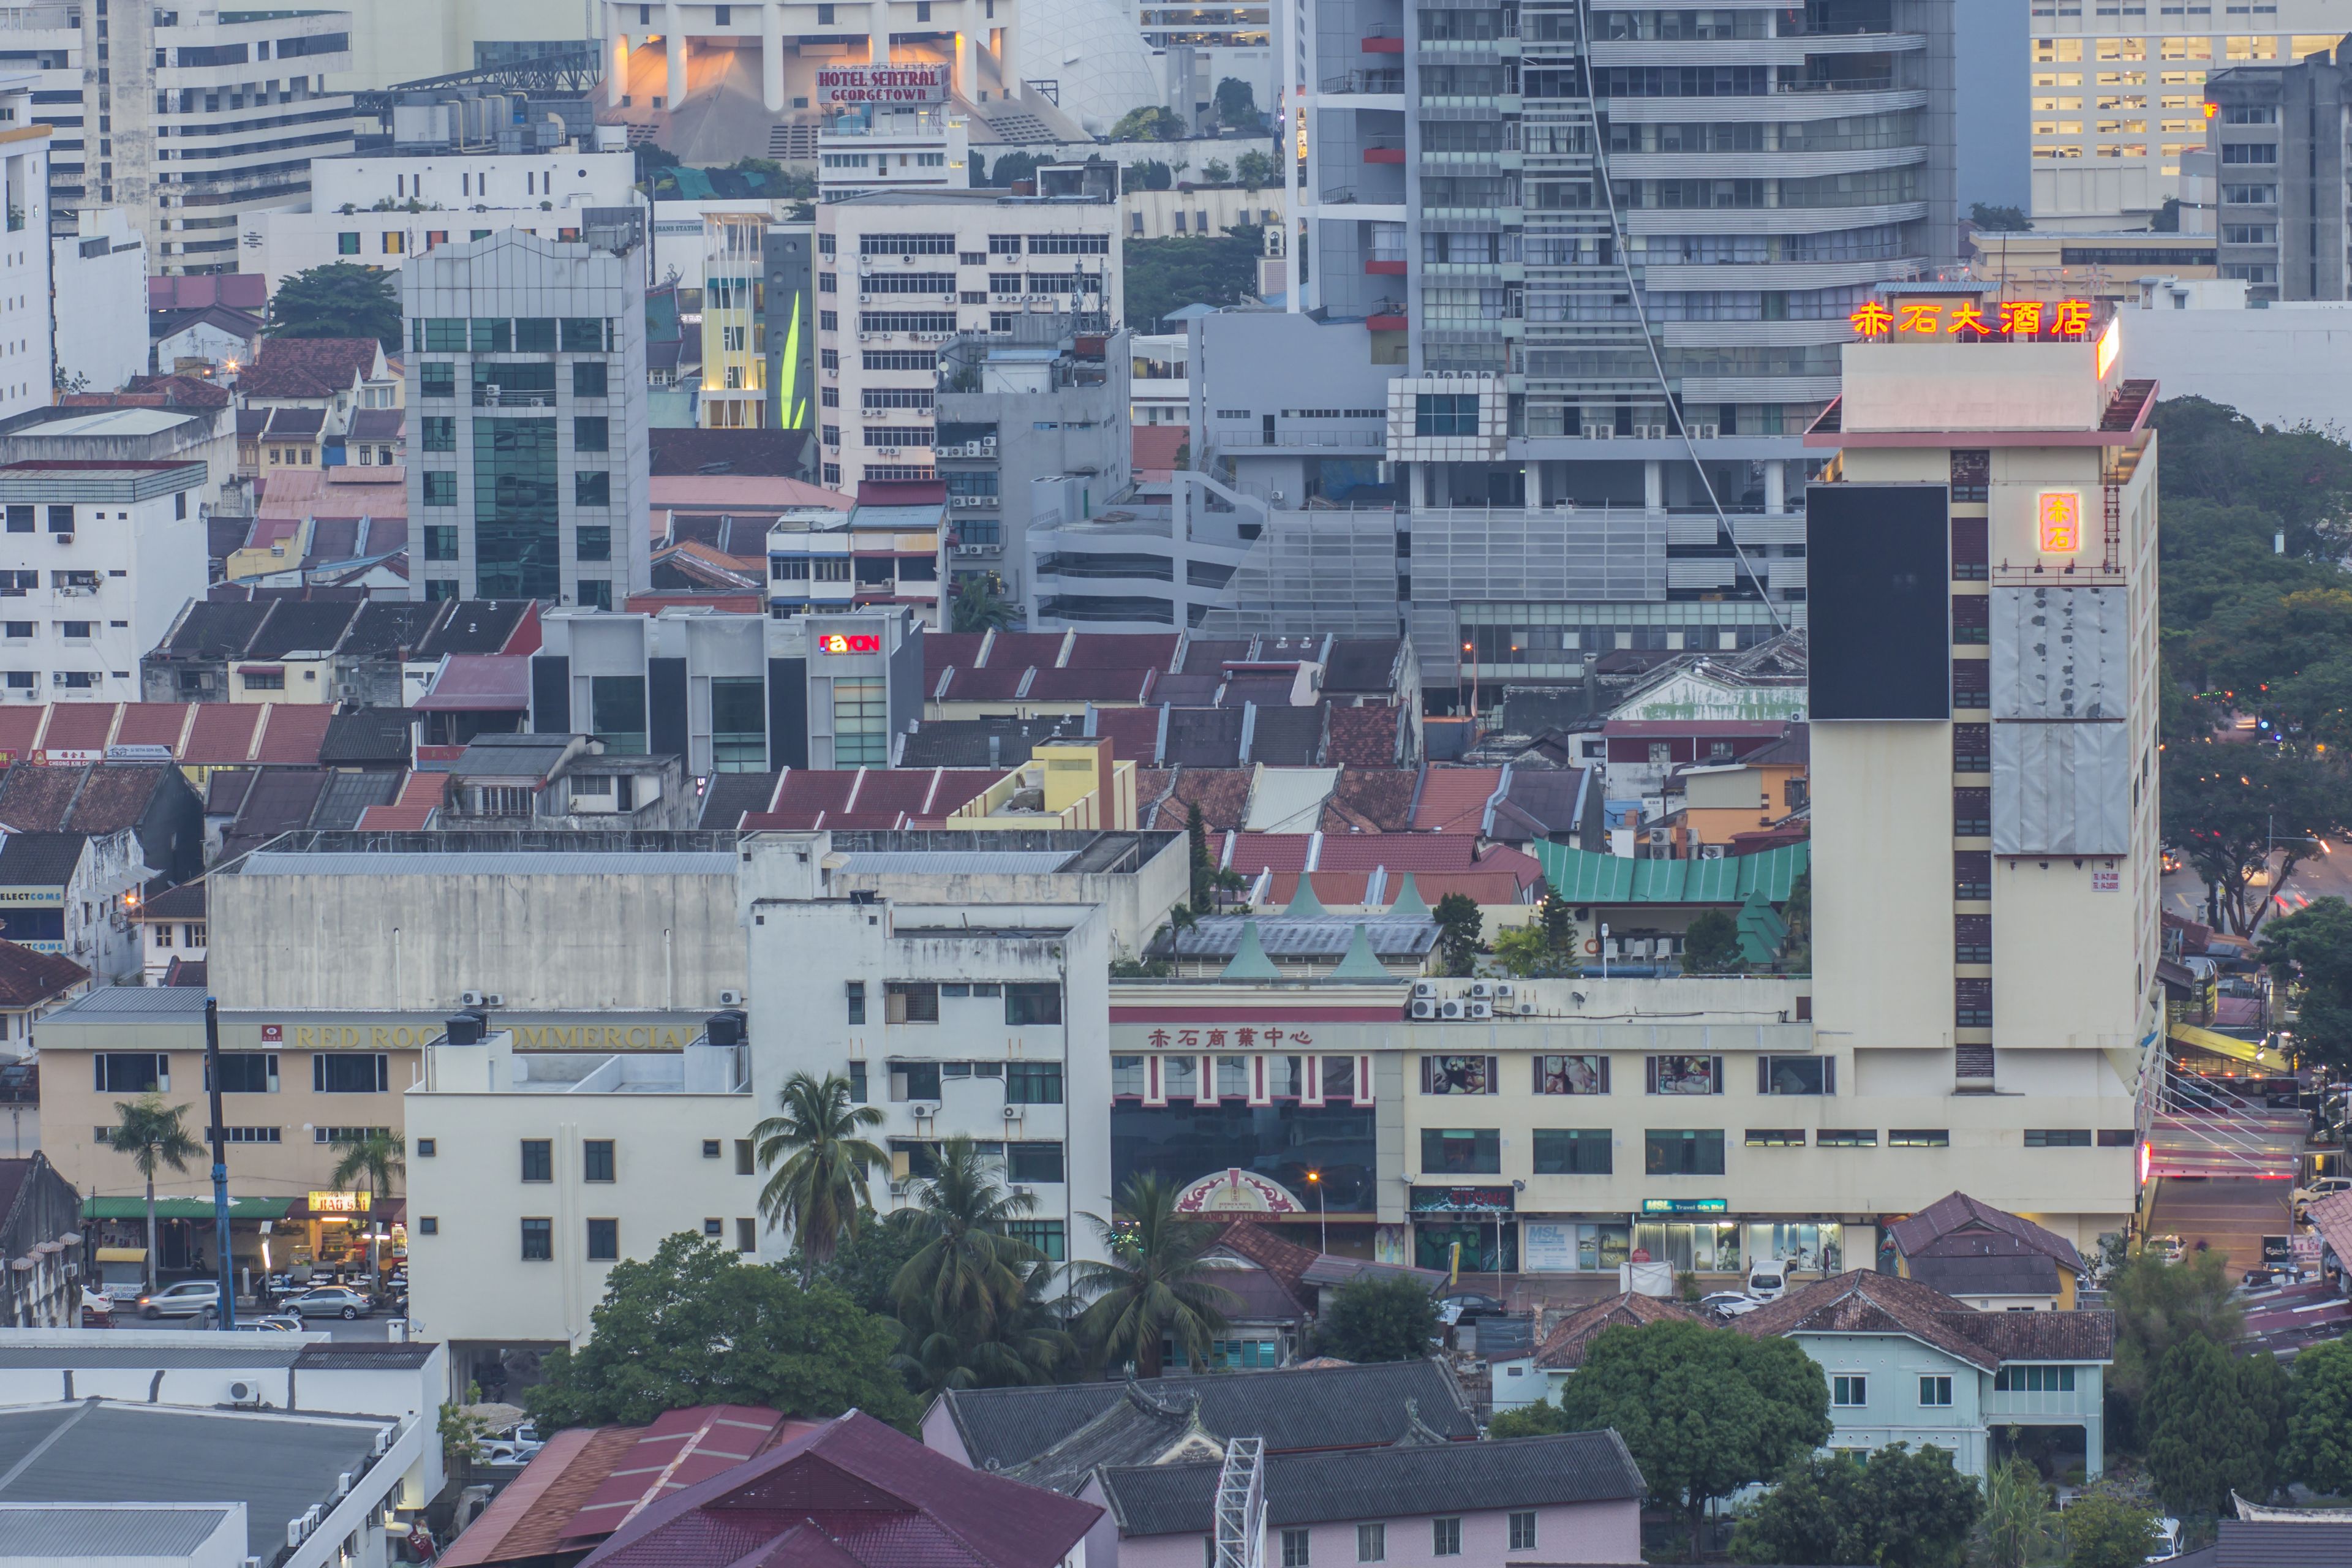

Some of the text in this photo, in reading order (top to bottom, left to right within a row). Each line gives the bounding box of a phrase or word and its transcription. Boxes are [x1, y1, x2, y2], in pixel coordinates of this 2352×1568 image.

[819, 71, 938, 86] HOTEL SENTRAL
[831, 89, 926, 100] GEORGETOWN
[1850, 300, 2092, 335] 赤石大酒店
[2048, 499, 2070, 547] 赤石
[294, 1027, 696, 1049] RED ROC OMMERCIA
[1148, 1027, 1313, 1047] 赤石商業中心
[1450, 1191, 1509, 1205] STONE
[1646, 1200, 1672, 1210] MSL
[1529, 1226, 1564, 1237] MSL
